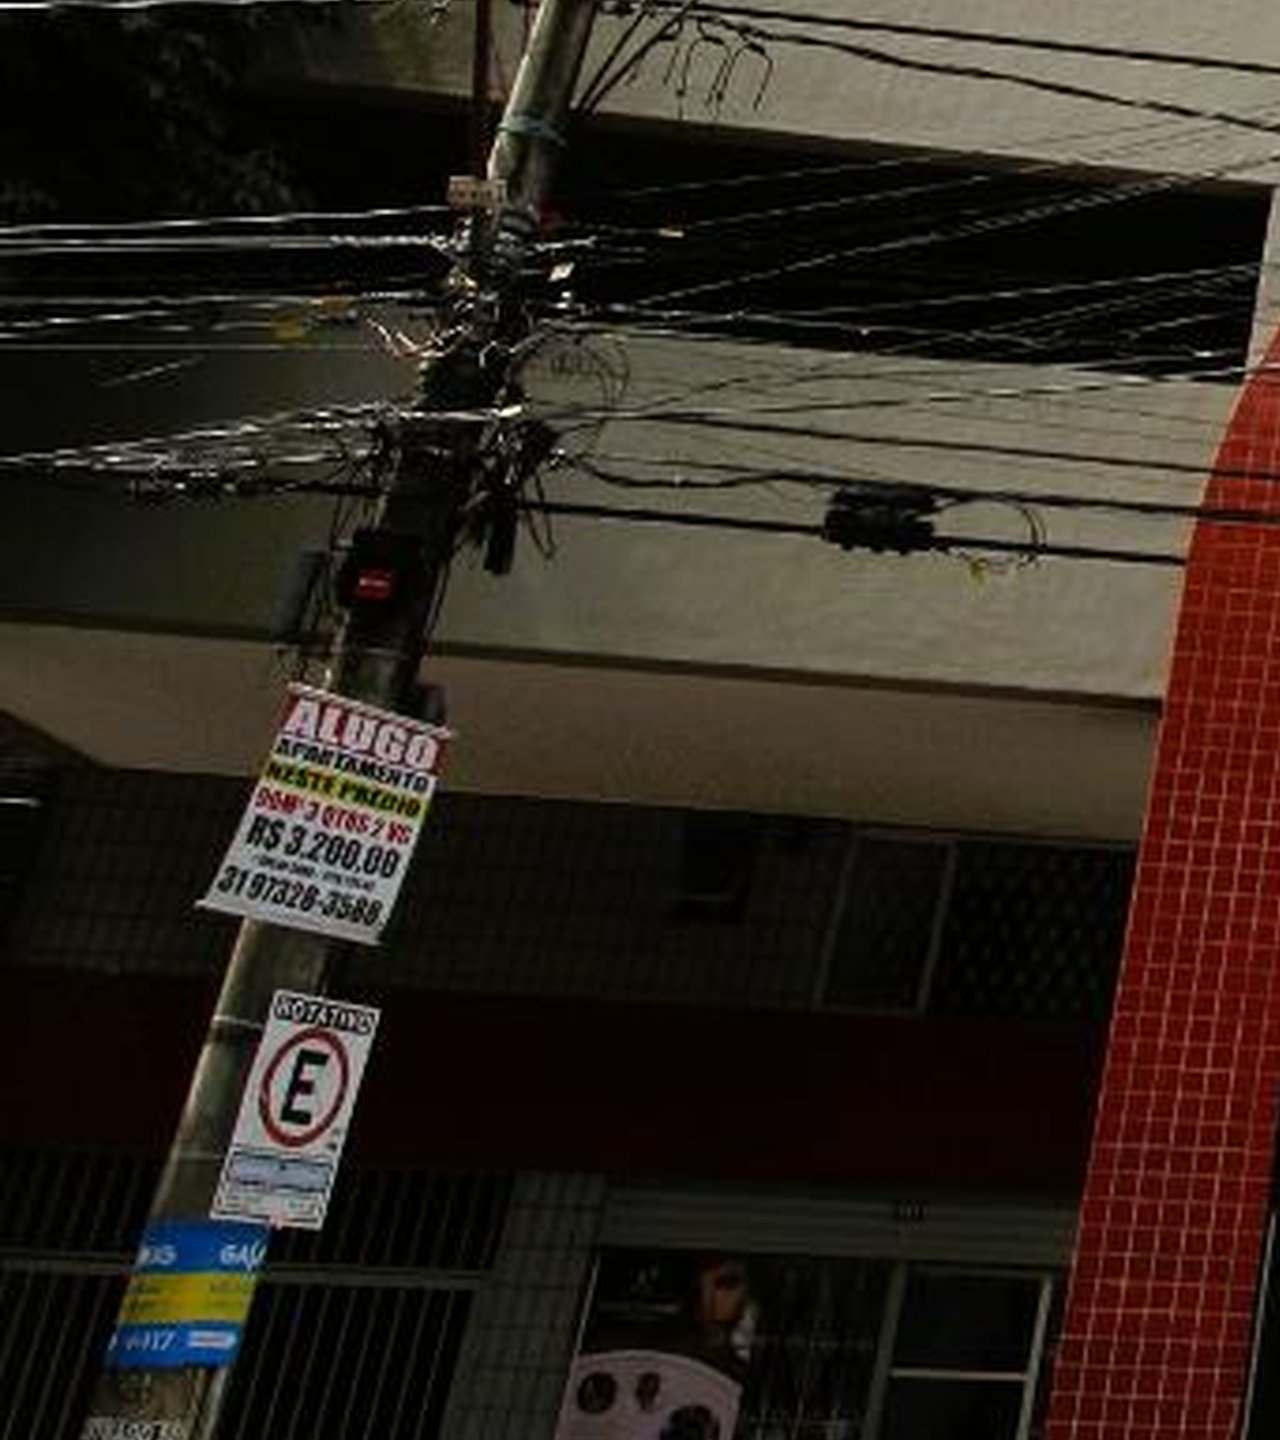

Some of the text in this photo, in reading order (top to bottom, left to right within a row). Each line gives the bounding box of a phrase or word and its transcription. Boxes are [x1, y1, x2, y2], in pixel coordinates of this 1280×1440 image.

[283, 700, 440, 771] ALUGO
[265, 762, 335, 796] NESTE
[275, 738, 430, 791] APARTAMENTO
[246, 817, 285, 850] R$
[284, 824, 401, 878] 3.200,00
[274, 997, 376, 1035] ROTATIVO
[280, 1048, 330, 1126] E
